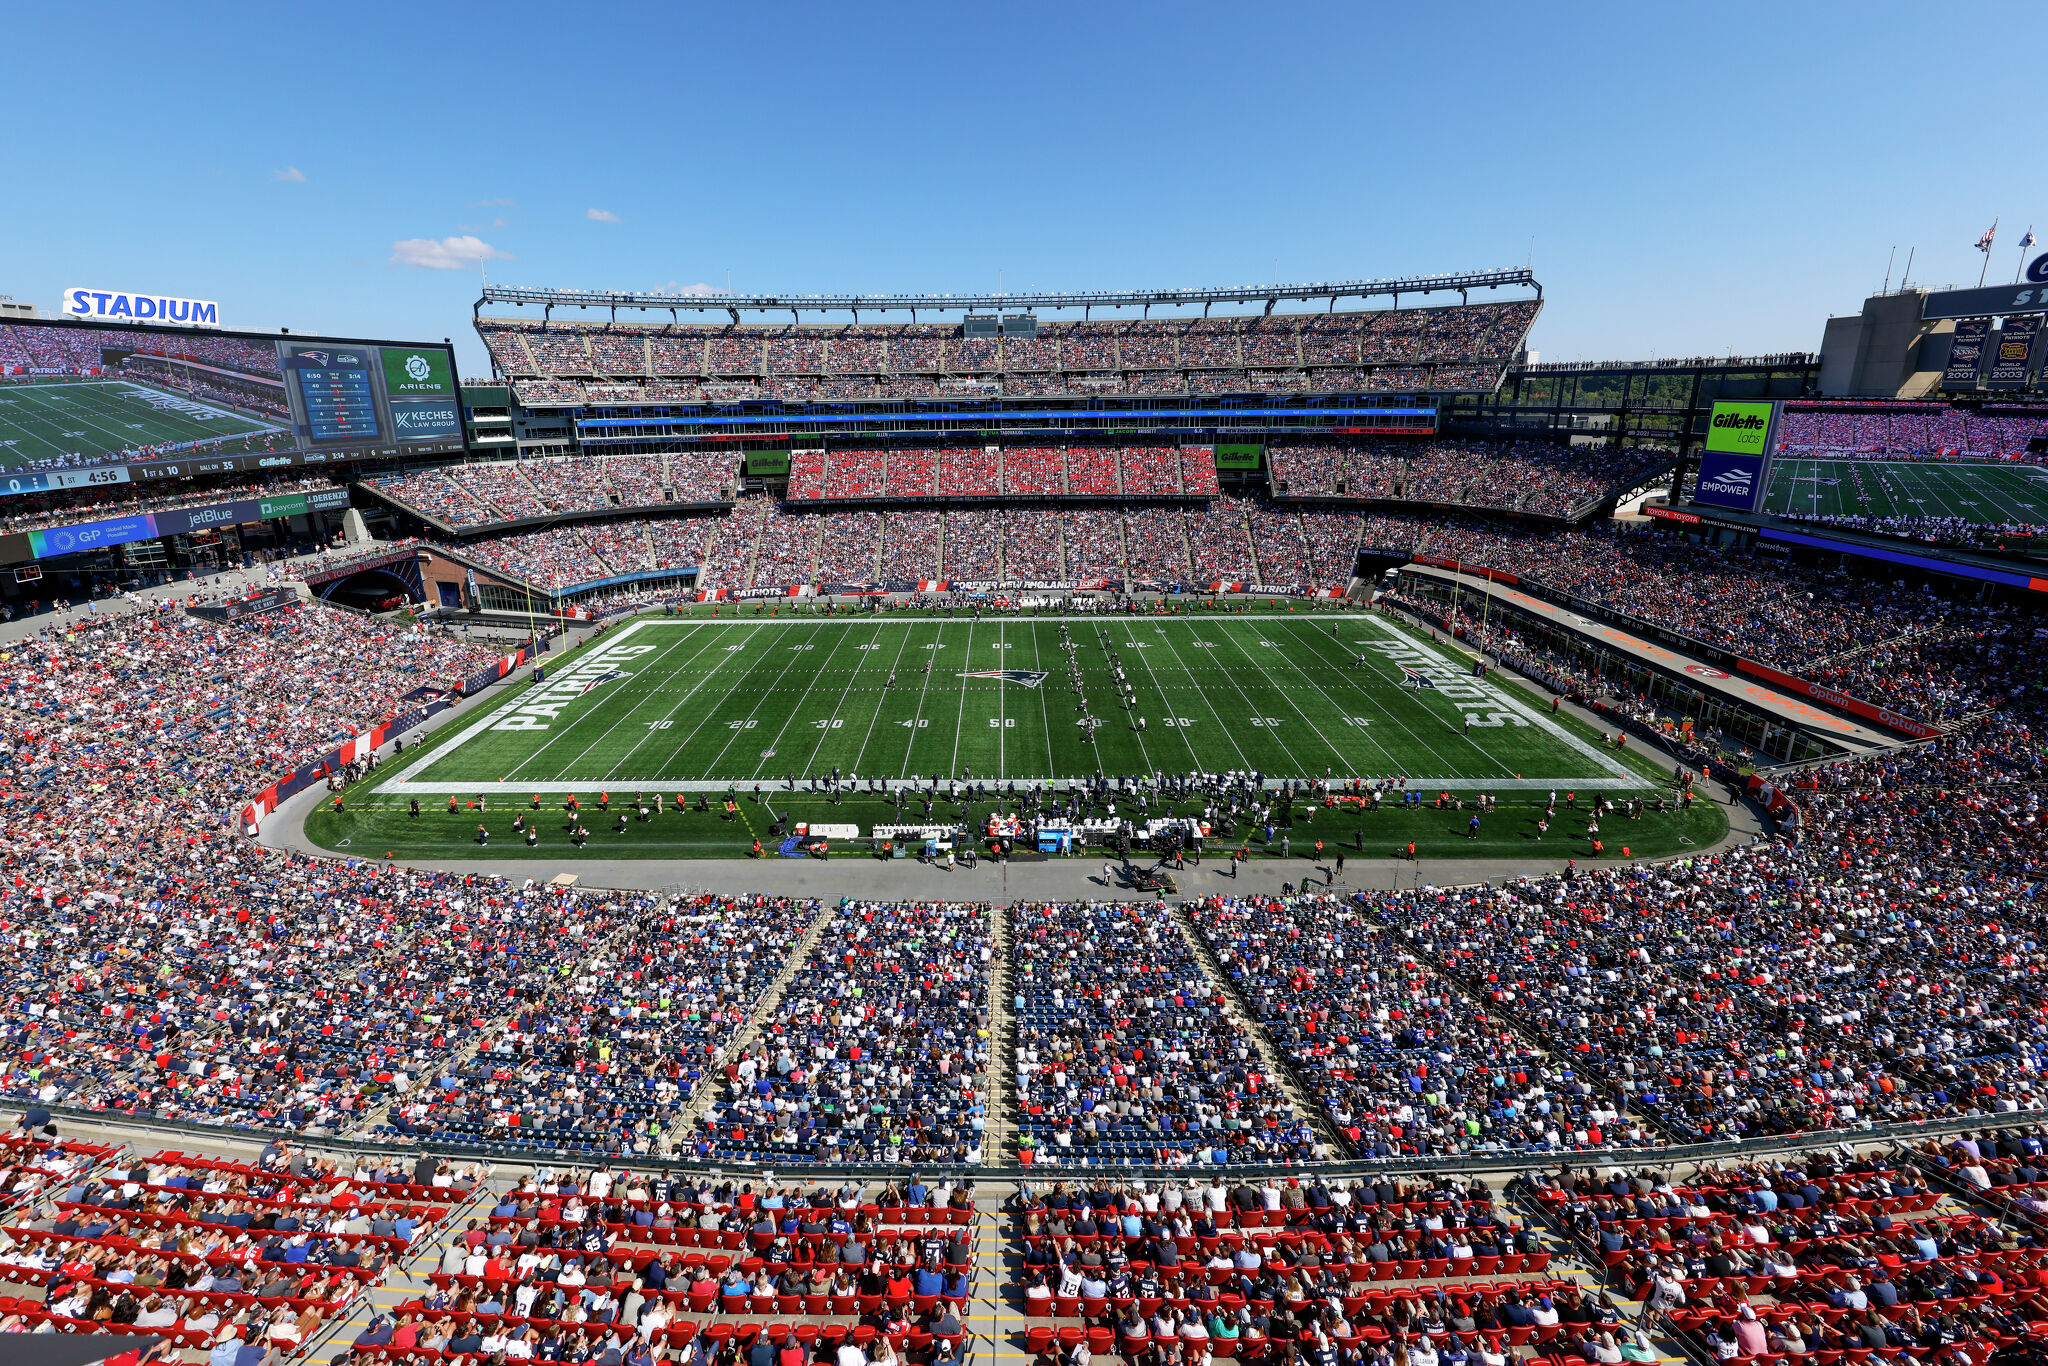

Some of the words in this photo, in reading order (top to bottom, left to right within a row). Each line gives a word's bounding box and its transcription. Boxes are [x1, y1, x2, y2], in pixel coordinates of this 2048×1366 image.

[72, 290, 216, 323] STADIUM
[1992, 371, 2023, 379] 2003
[411, 411, 454, 421] KECHES
[1713, 413, 1765, 430] Gillette
[1737, 431, 1760, 444] Labs
[259, 457, 292, 467] Gillette
[752, 458, 784, 467] Gillette
[1221, 452, 1255, 463] Gillette
[166, 465, 179, 476] 10
[222, 461, 234, 470] 35
[88, 470, 118, 483] 4:56
[9, 479, 21, 492] 0
[1701, 481, 1749, 496] EMPOWER
[306, 491, 348, 504] J.DERENZO
[273, 502, 305, 513] paycom
[188, 509, 233, 527] jetBlue
[1647, 507, 1669, 518] TOYOTA
[1673, 513, 1698, 523] TOYOTA
[1701, 519, 1725, 528] FRANKLIN
[1726, 522, 1758, 533] TEMPLETON
[195, 533, 220, 544] 4:56
[23, 567, 38, 579] 14
[305, 574, 331, 586] OYOTA
[333, 564, 361, 578] TOYOTA
[363, 557, 387, 571] TOYOTA
[389, 550, 414, 563] TOYOTA
[953, 581, 998, 589] FOREVER
[1021, 580, 1070, 589] ENGLAND
[1250, 584, 1297, 594] PATRIOT
[1501, 652, 1524, 669] NEW
[1522, 664, 1569, 693] ENGLAND
[489, 645, 657, 731] PATRIOTS
[1354, 641, 1530, 728] PATRIOTS
[1809, 685, 1849, 708] Optum
[649, 720, 675, 730] 10
[729, 719, 758, 729] 20
[816, 719, 844, 729] 30
[901, 719, 929, 729] 40
[989, 718, 1016, 727] 50
[1163, 718, 1190, 727] 30
[1250, 717, 1280, 726] 20
[1342, 717, 1369, 726] 10
[1878, 711, 1927, 737] Optum
[277, 1193, 286, 1202] 12
[655, 1189, 666, 1200] 75
[1828, 1221, 1836, 1232] 6
[584, 1240, 601, 1252] 85
[1506, 1245, 1515, 1255] 9
[1064, 1281, 1078, 1295] 12
[1115, 1286, 1129, 1298] 12
